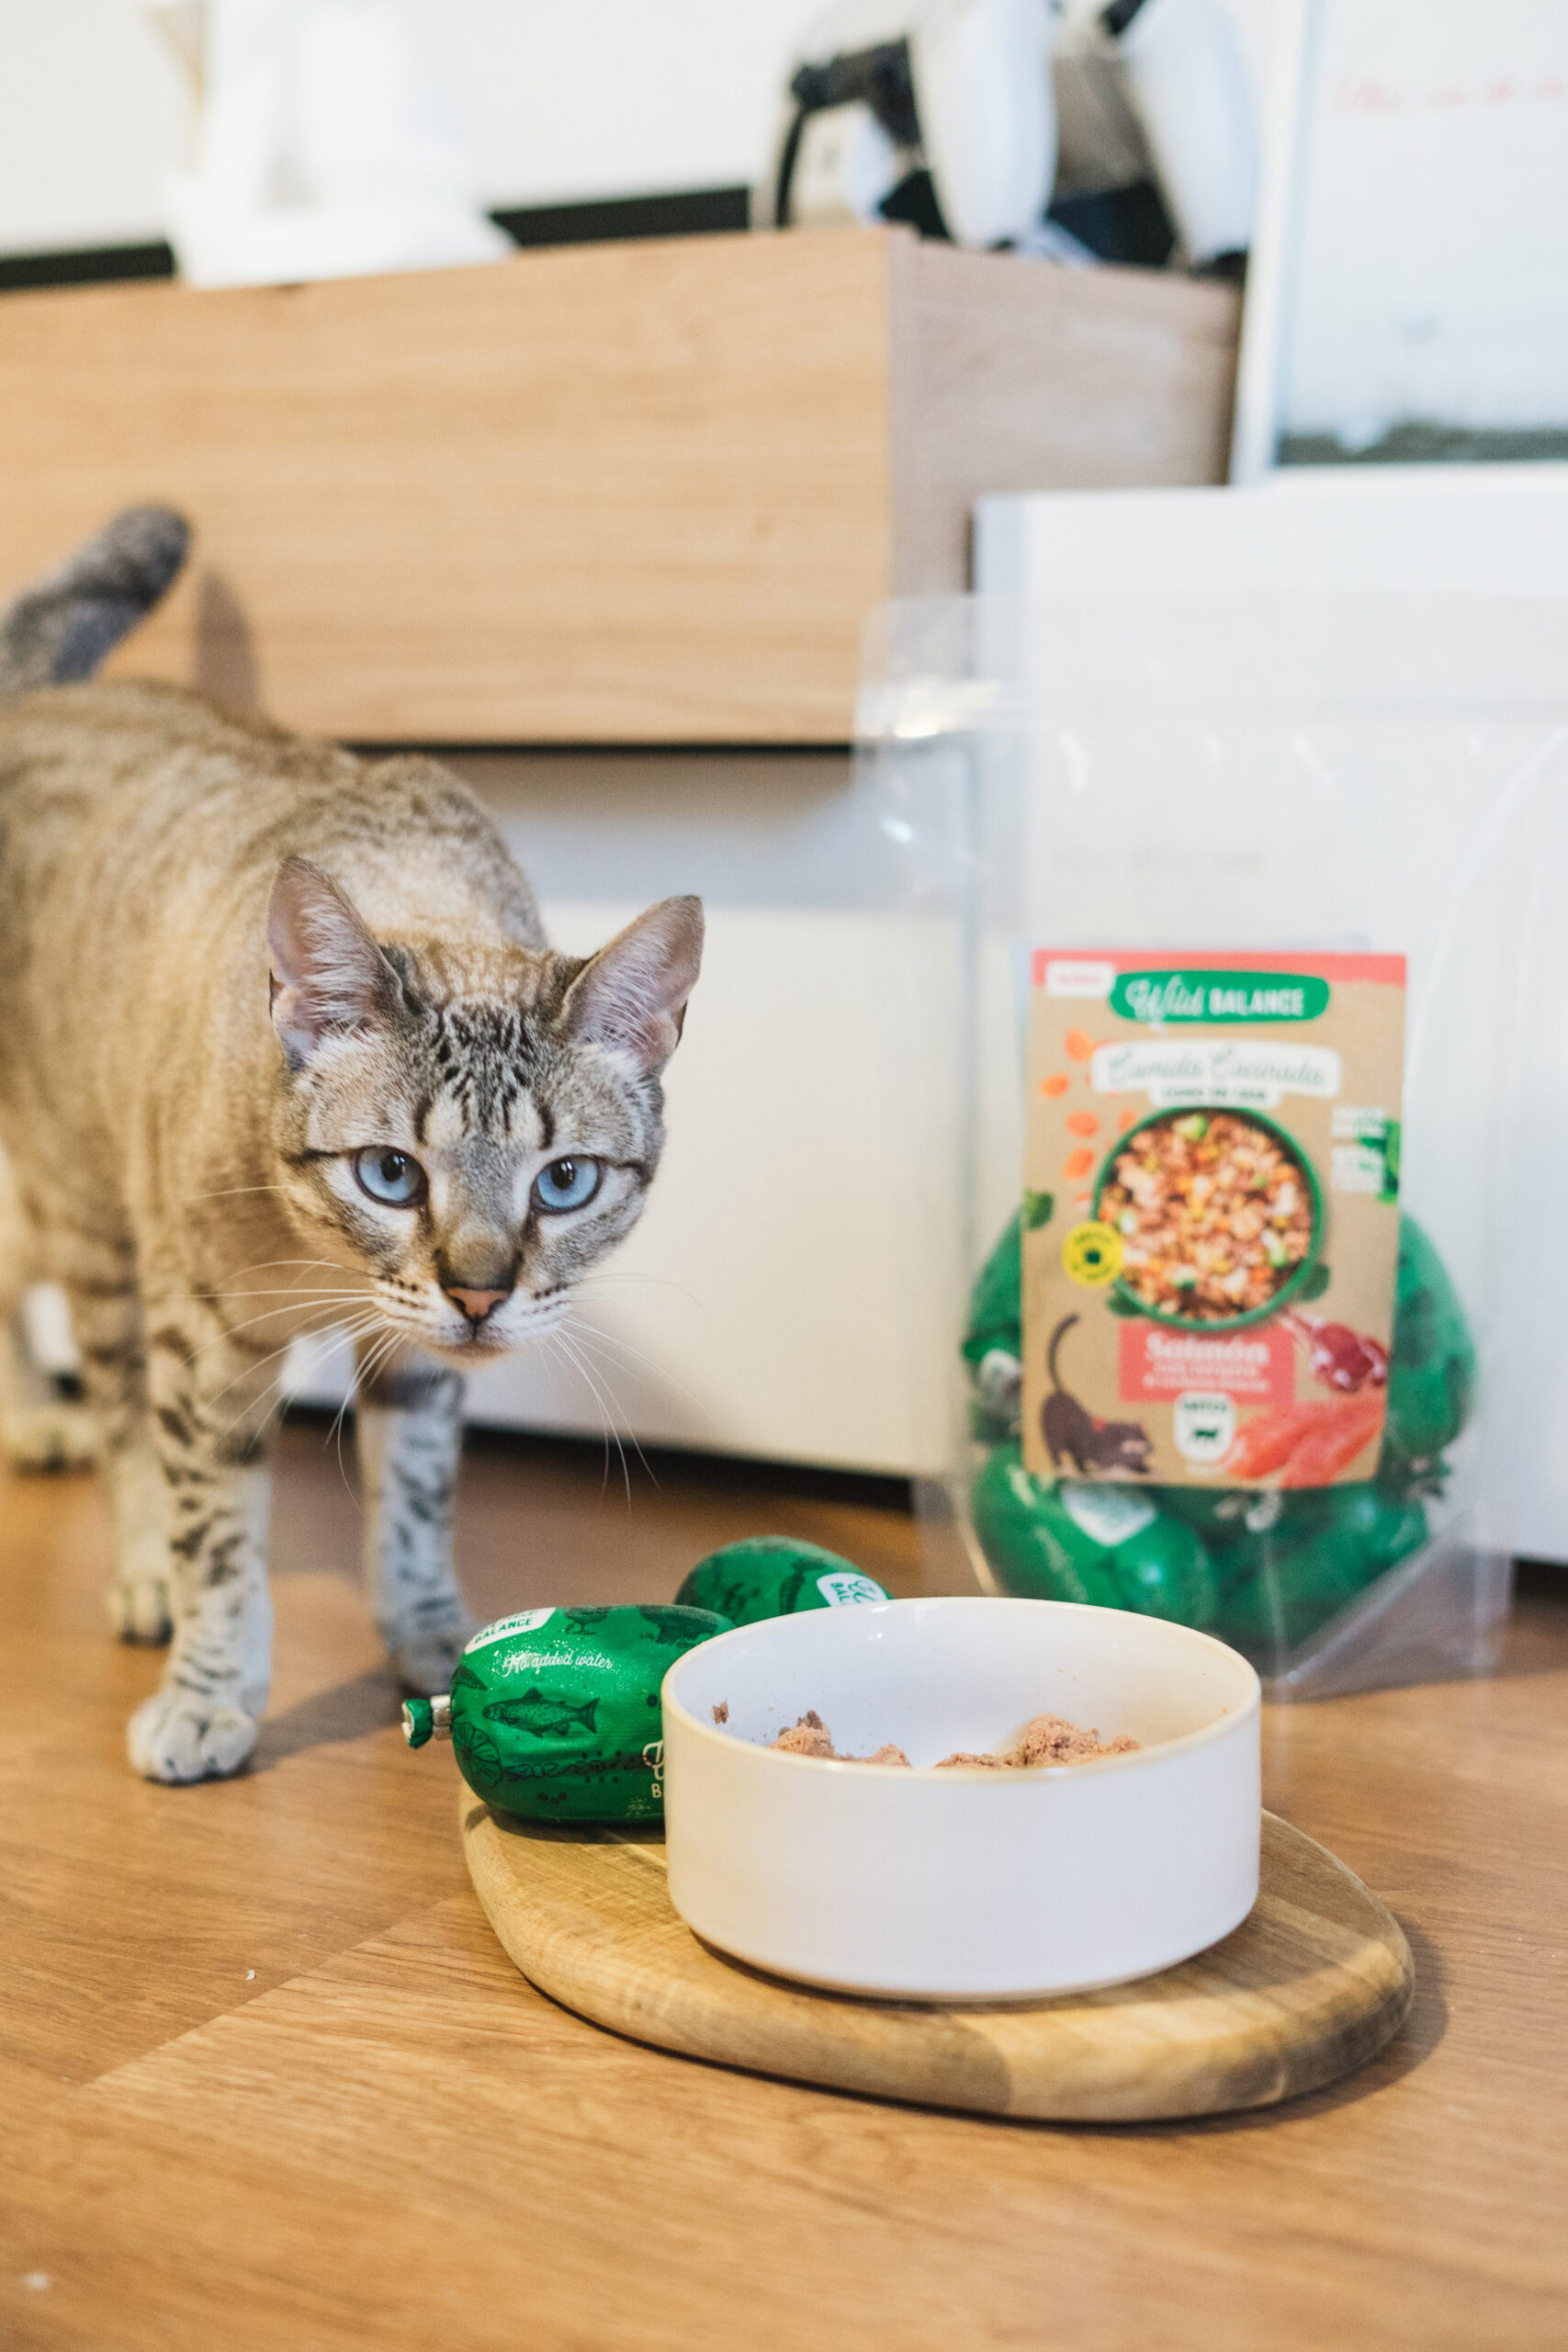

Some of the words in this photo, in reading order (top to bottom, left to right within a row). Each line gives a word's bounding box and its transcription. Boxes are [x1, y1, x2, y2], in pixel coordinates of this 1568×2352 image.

[1125, 975, 1204, 1023] Wild
[1209, 987, 1304, 1017] BALANCE
[474, 1617, 534, 1644] BALANCE
[502, 1654, 531, 1678] No
[531, 1650, 572, 1669] added
[575, 1652, 614, 1669] water
